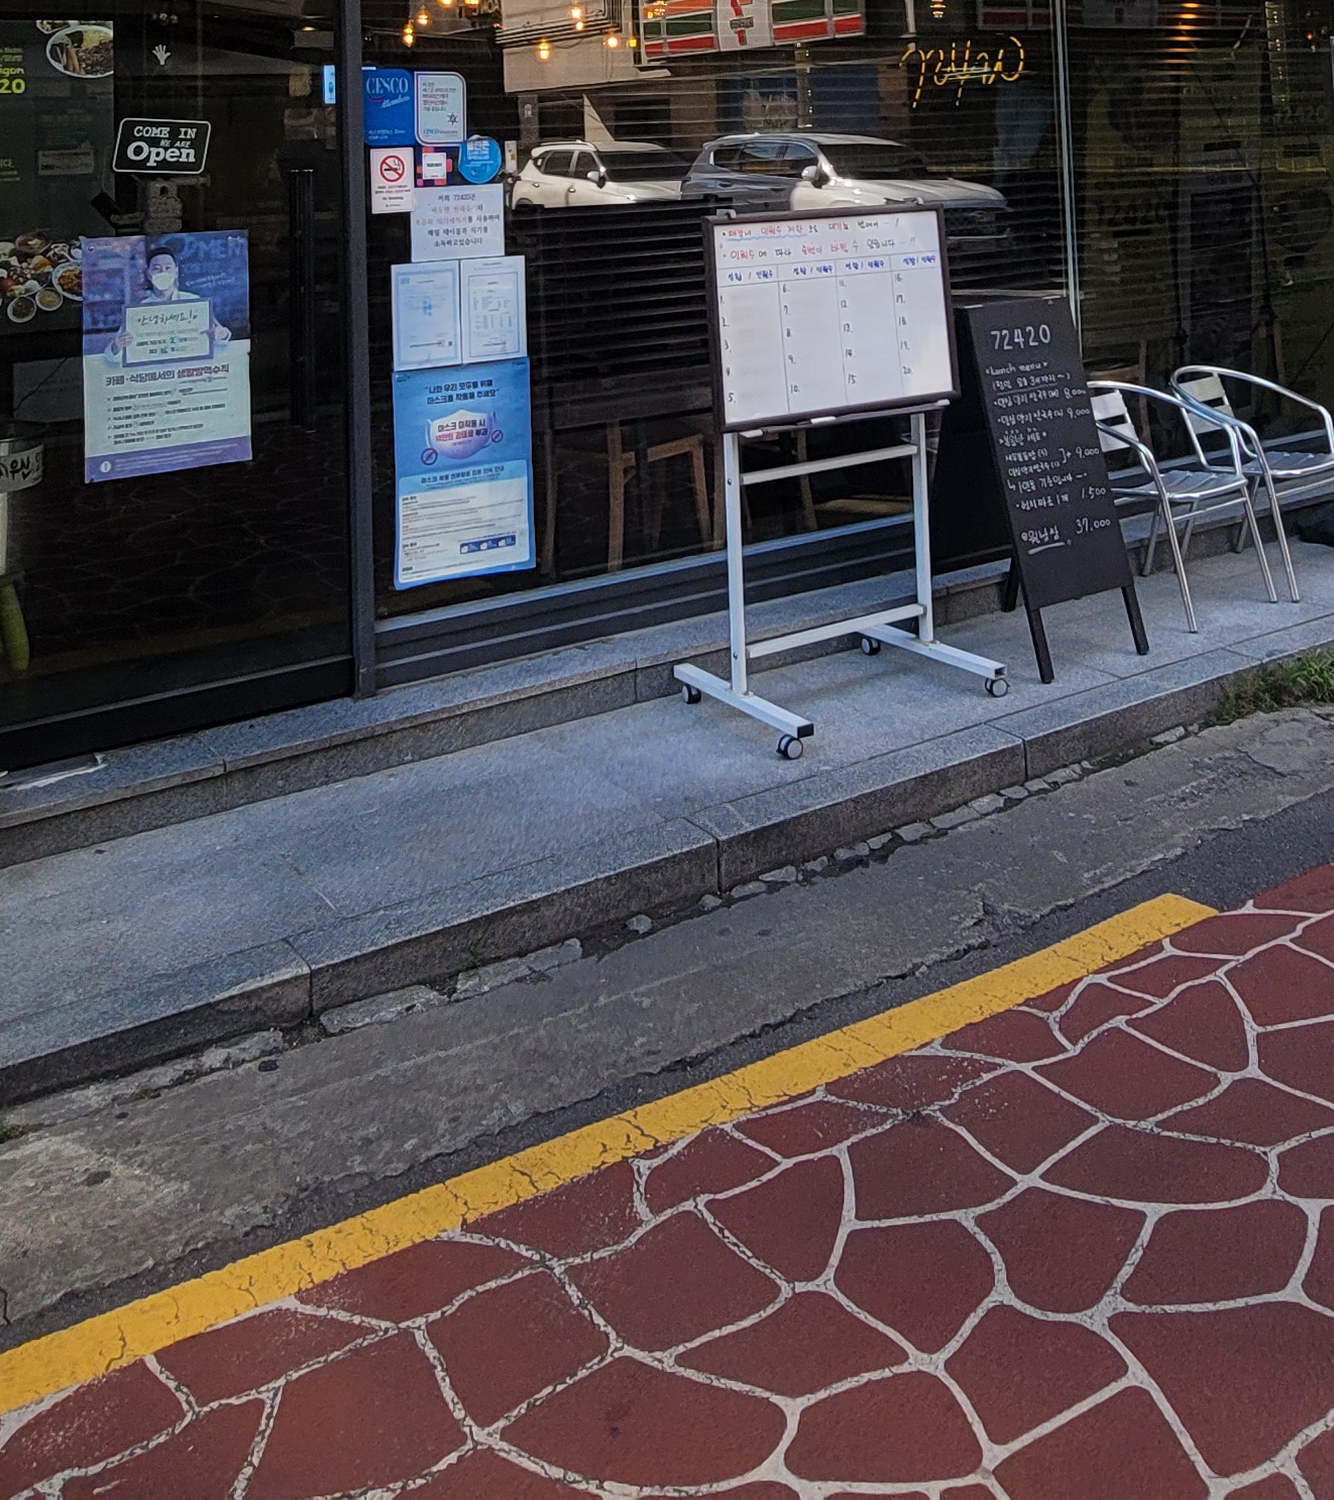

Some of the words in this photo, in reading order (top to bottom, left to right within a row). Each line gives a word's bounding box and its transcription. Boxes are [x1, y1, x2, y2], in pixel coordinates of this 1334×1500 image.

[365, 77, 409, 94] CESCO
[133, 125, 171, 138] COME
[178, 127, 197, 139] IN
[126, 140, 197, 167] Open
[990, 323, 1052, 351] 72420
[437, 421, 457, 433] 마스크
[1075, 517, 1111, 534] 37.000
